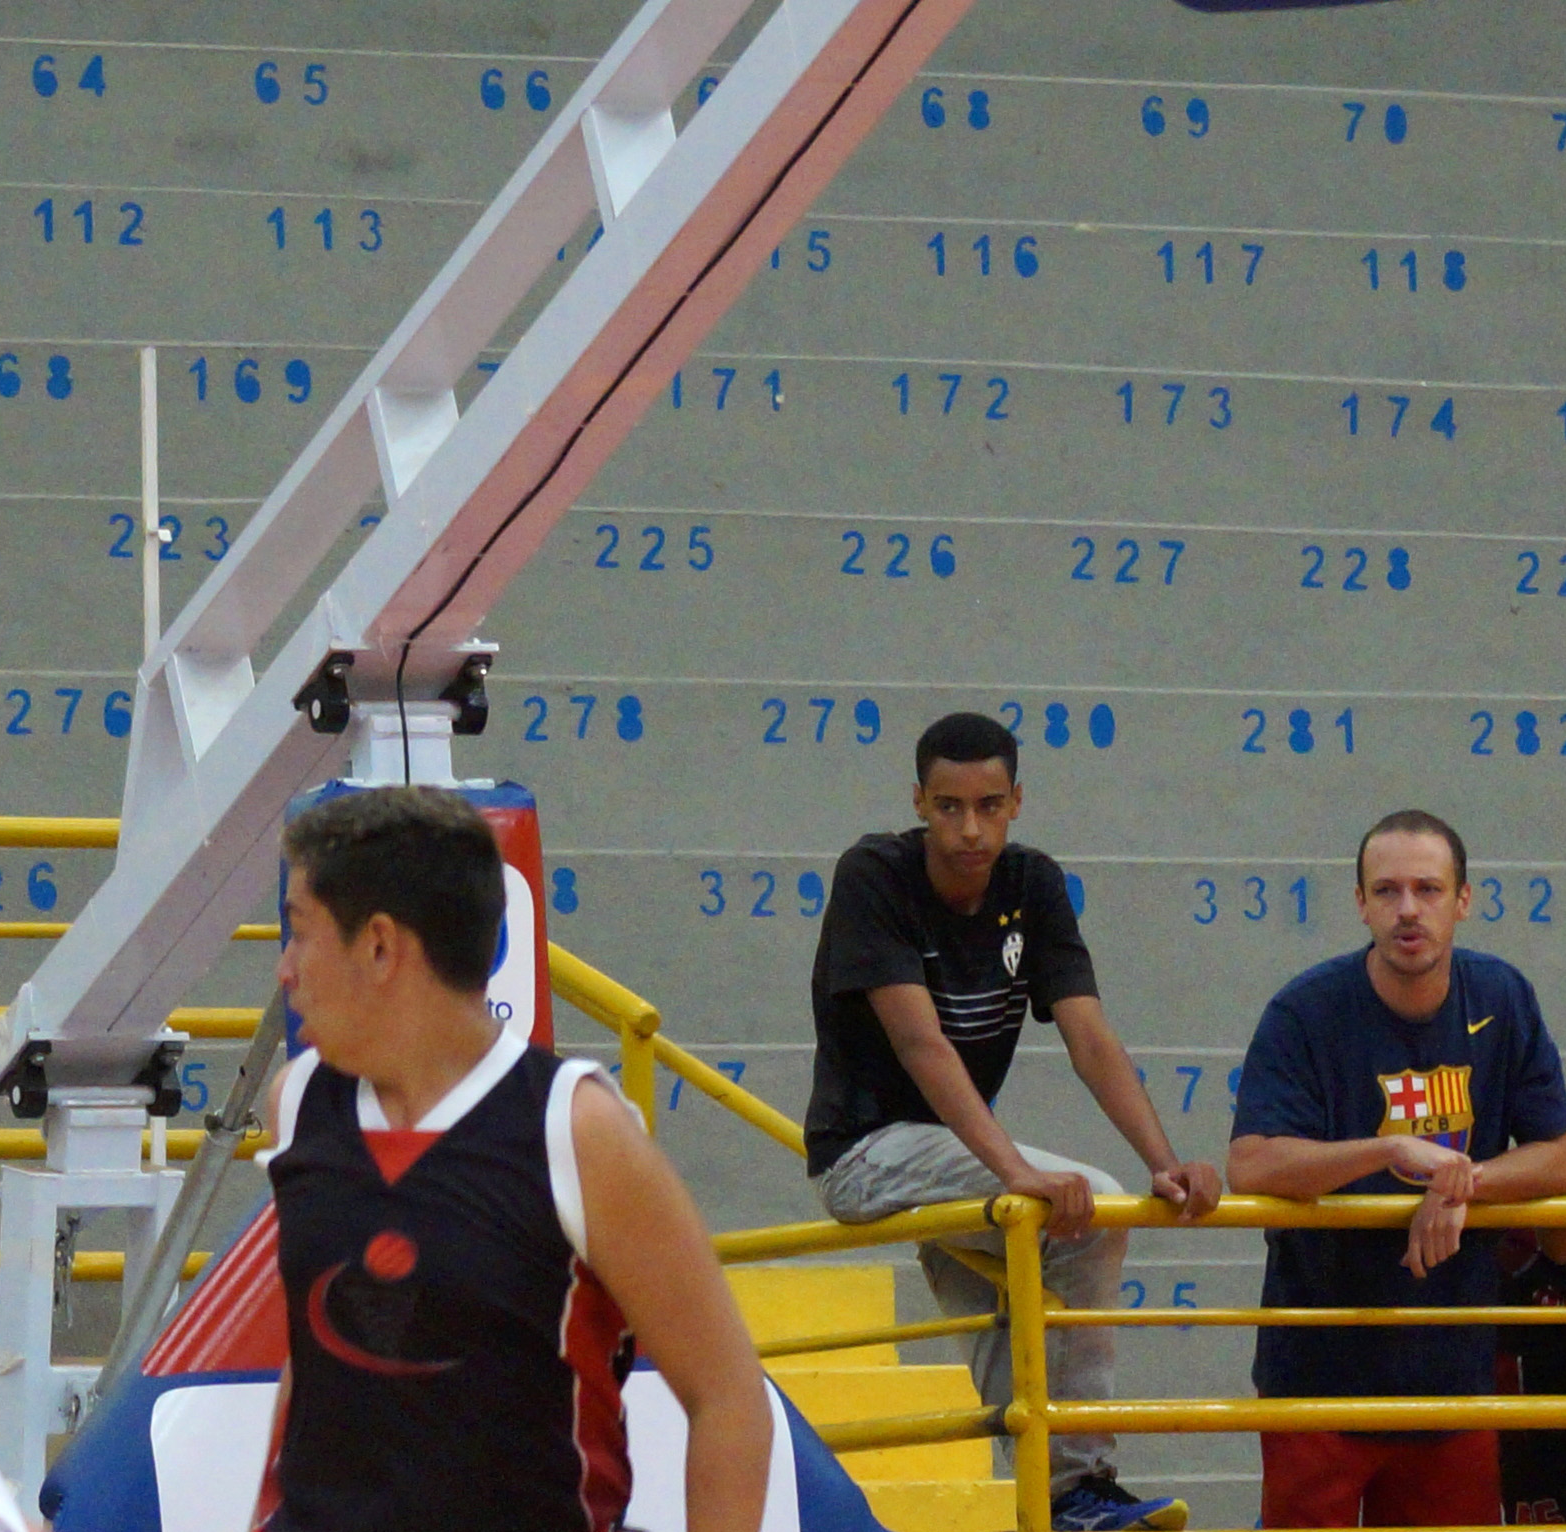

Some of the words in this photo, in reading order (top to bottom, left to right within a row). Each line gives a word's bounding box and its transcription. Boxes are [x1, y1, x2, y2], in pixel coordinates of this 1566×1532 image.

[30, 54, 108, 98] 64
[253, 61, 329, 106] 65
[478, 68, 553, 113] 66
[920, 86, 992, 131] 68
[1140, 95, 1211, 139] 69
[1342, 101, 1409, 144] 70
[32, 198, 146, 247] 112
[265, 207, 384, 252] 113
[926, 232, 1041, 279] 116
[1156, 241, 1265, 284] 117
[1361, 249, 1468, 292] 118
[188, 357, 313, 405] 169
[670, 367, 782, 411] 171
[891, 372, 1011, 421] 172
[1116, 381, 1234, 430] 173
[1340, 393, 1458, 441] 174
[107, 512, 232, 562] 223
[594, 523, 715, 572] 225
[839, 530, 958, 579] 226
[1069, 536, 1187, 585] 227
[1299, 544, 1413, 593] 228
[5, 687, 134, 739] 276
[522, 694, 646, 743] 278
[761, 697, 883, 746] 279
[999, 700, 1118, 749] 280
[1240, 707, 1356, 755] 281
[699, 869, 826, 918] 329
[1192, 875, 1310, 925] 331
[1480, 876, 1554, 924] 32
